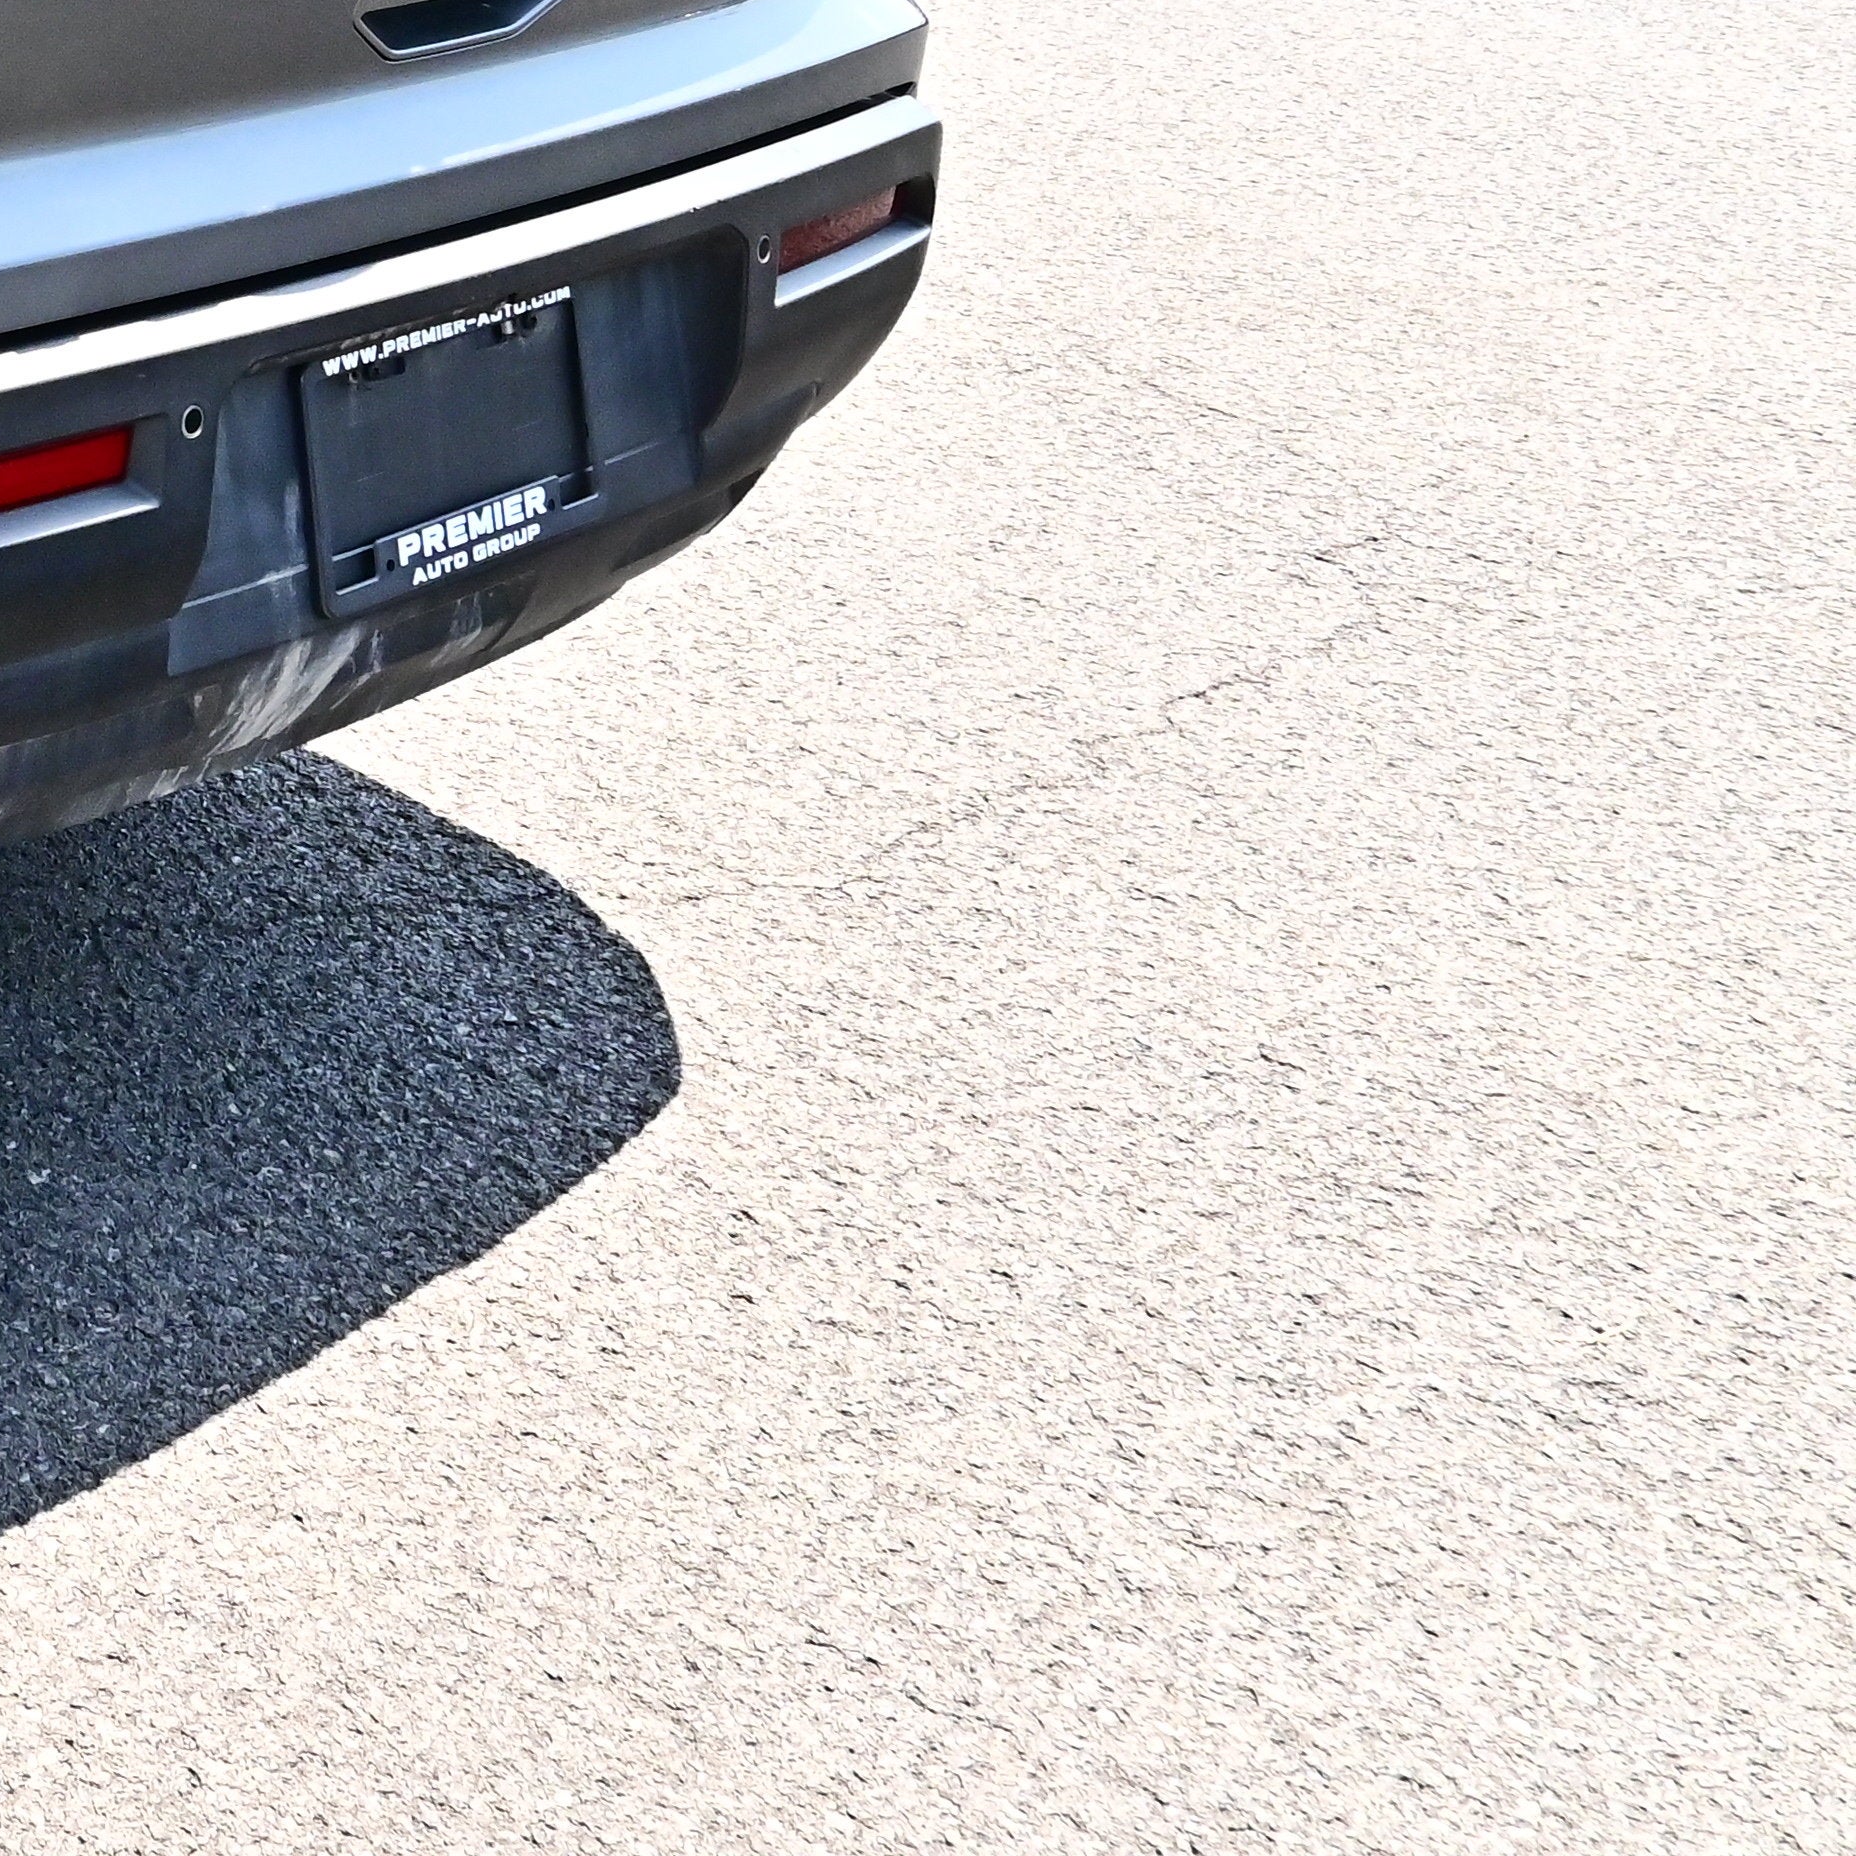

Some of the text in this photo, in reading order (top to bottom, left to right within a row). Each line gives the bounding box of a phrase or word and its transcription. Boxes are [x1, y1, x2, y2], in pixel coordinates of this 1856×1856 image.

[397, 486, 548, 567] PREMIER
[412, 523, 541, 586] AUTO GROUP
